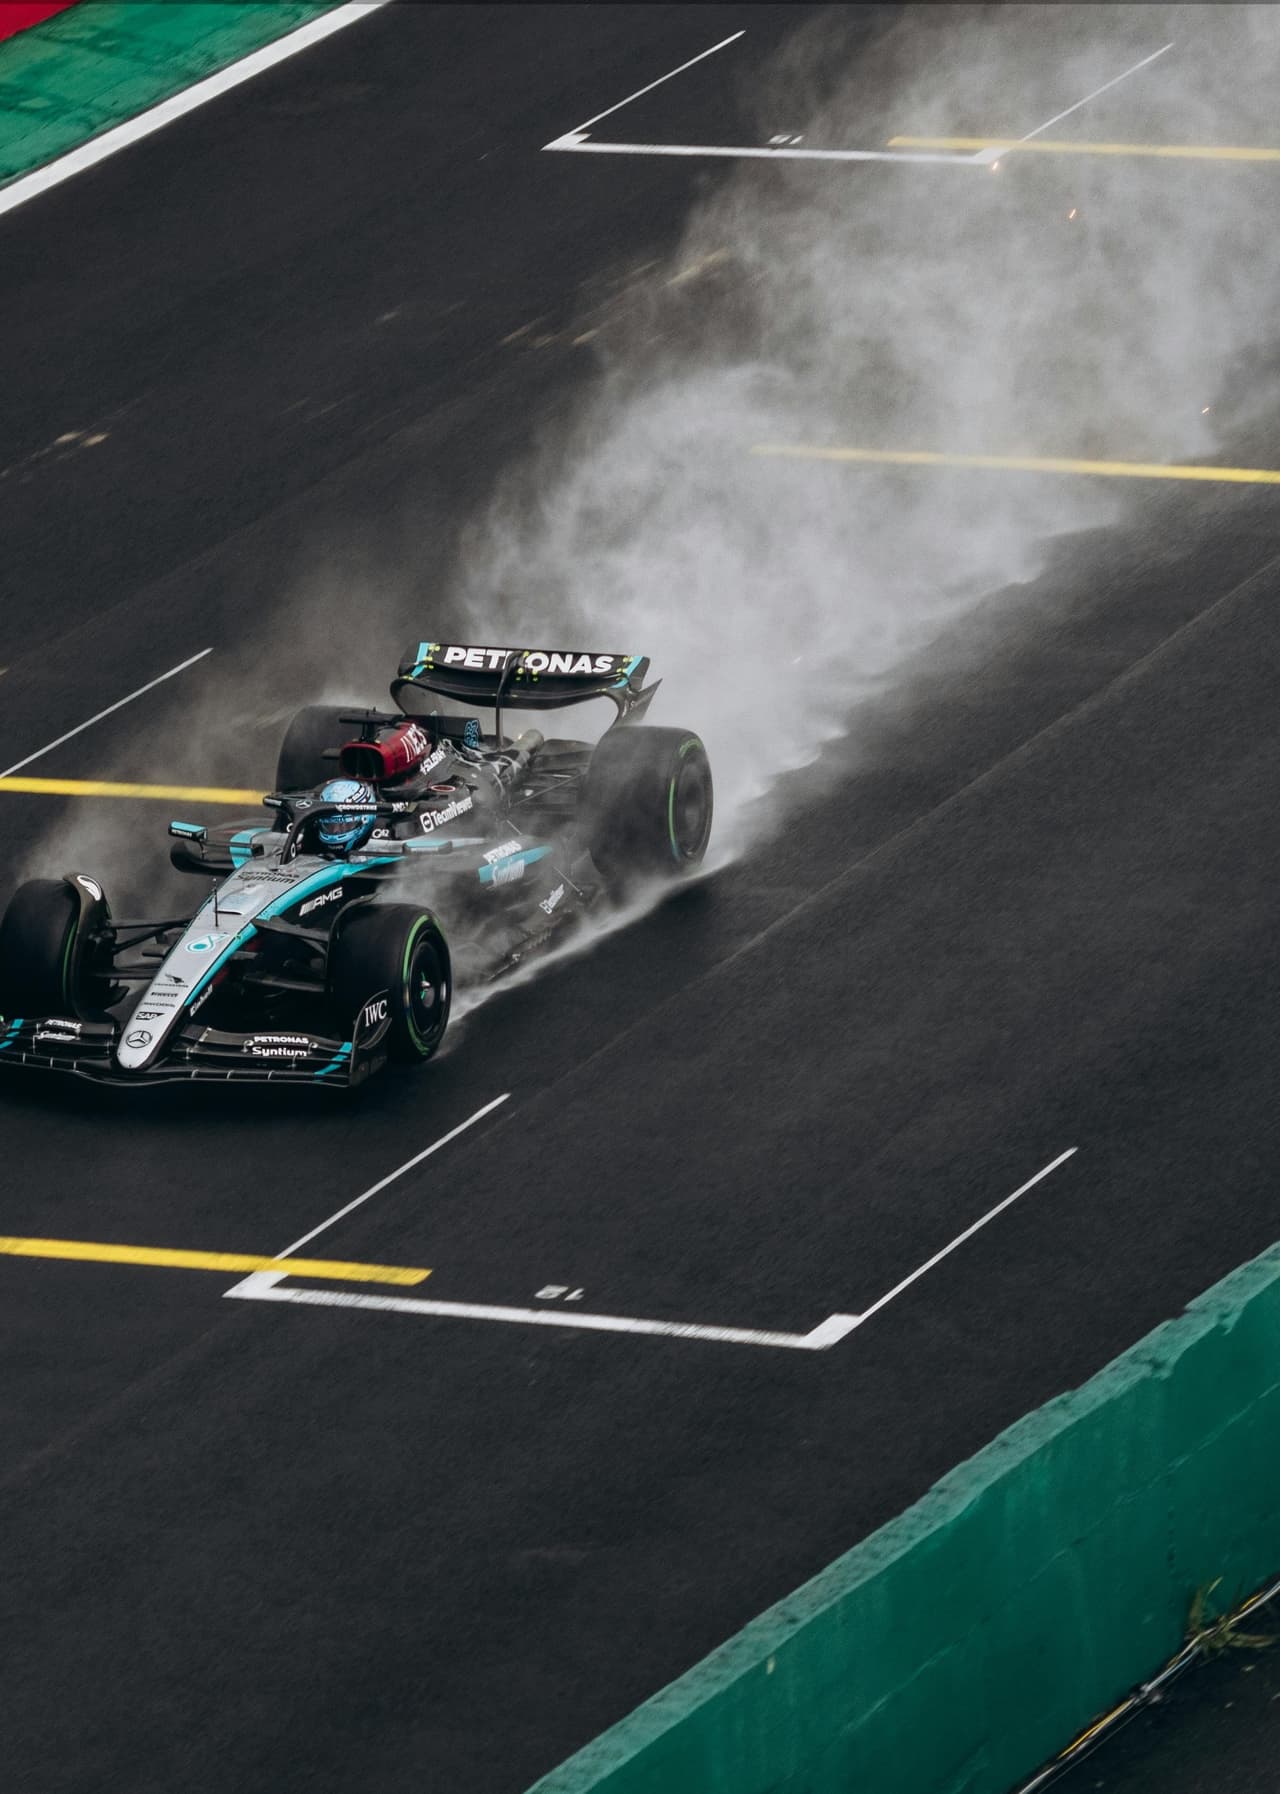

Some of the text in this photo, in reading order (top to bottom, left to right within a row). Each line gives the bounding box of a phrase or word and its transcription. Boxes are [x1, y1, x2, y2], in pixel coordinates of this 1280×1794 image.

[431, 796, 473, 827] TeamViewer
[312, 886, 344, 909] AMG
[137, 1012, 158, 1020] SAP
[364, 999, 388, 1027] IWC
[253, 1036, 309, 1044] PETRONAS
[252, 1046, 307, 1057] Syntium
